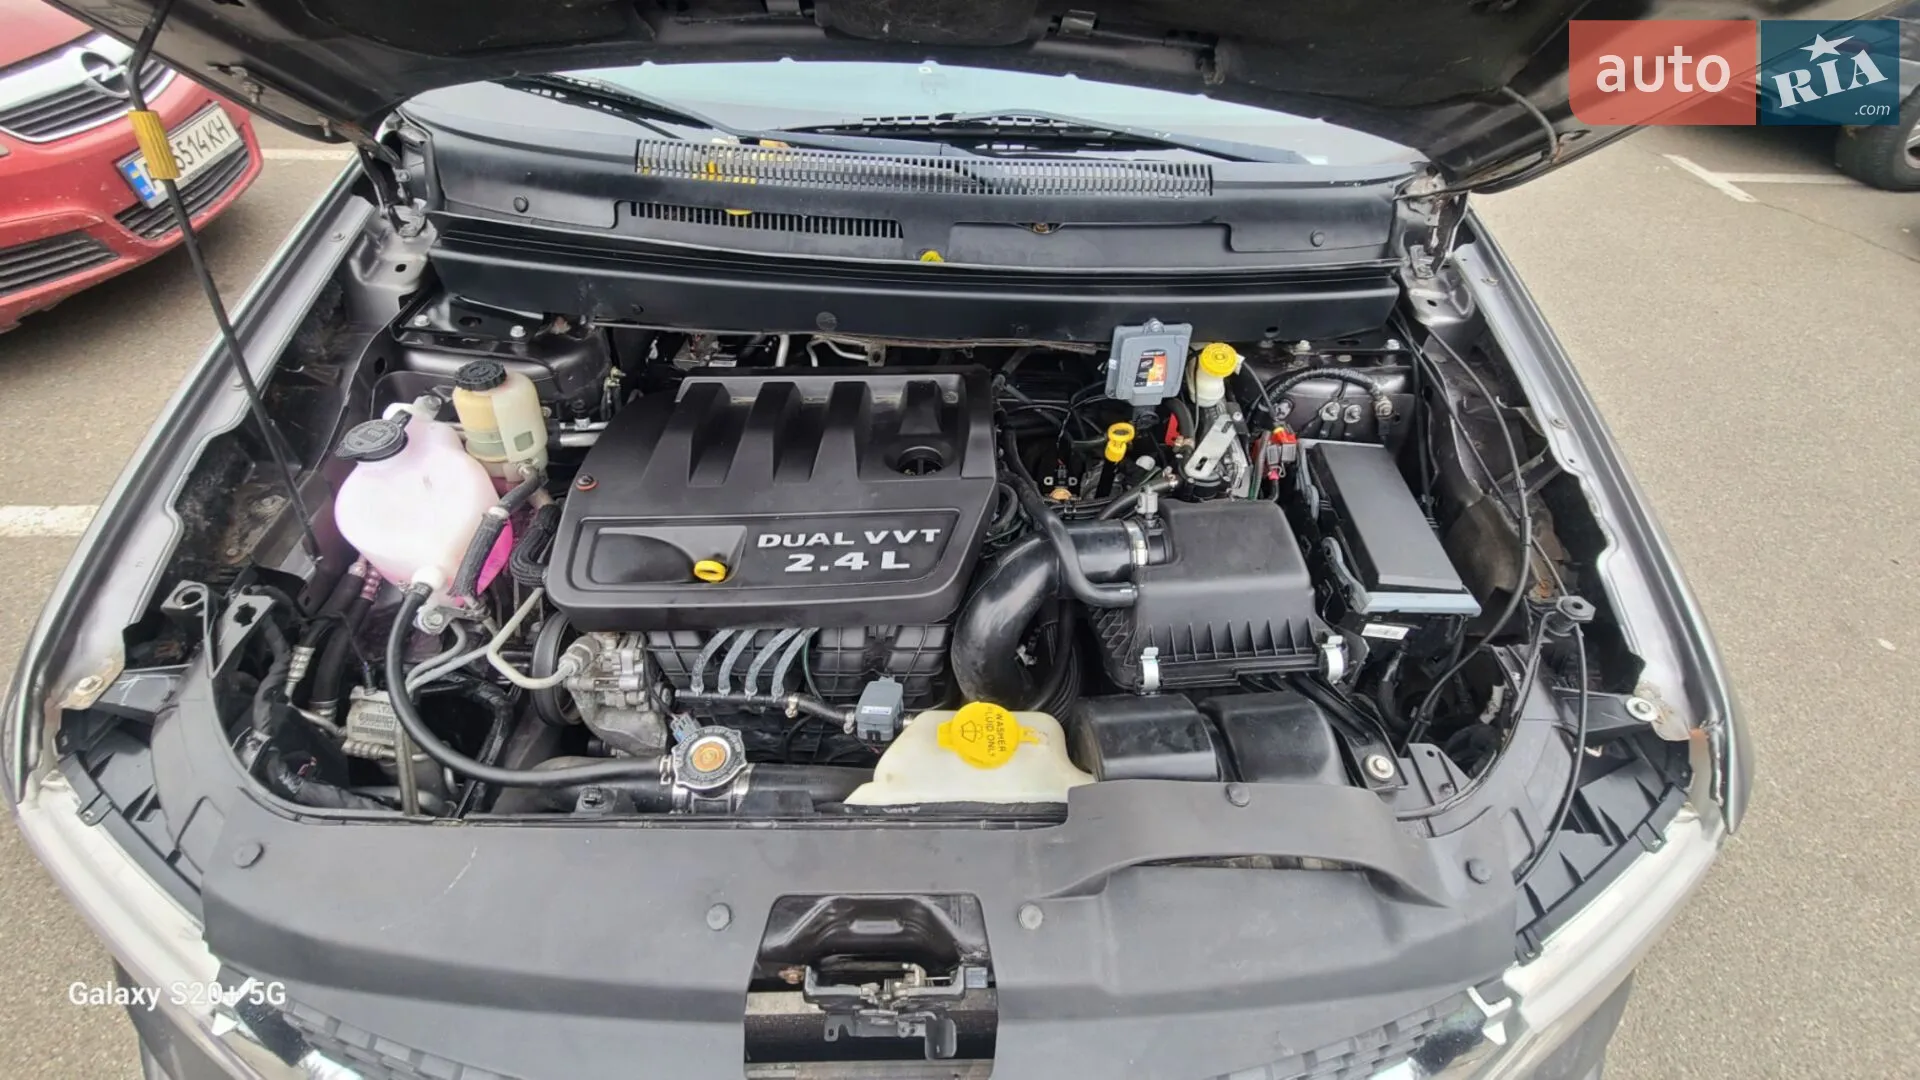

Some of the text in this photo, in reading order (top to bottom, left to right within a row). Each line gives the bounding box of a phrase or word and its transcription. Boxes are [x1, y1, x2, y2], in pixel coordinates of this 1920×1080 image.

[757, 528, 942, 548] DUAL VVT
[784, 550, 910, 572] 2.4 L
[996, 714, 1007, 752] WASHER
[986, 734, 996, 757] ONLY
